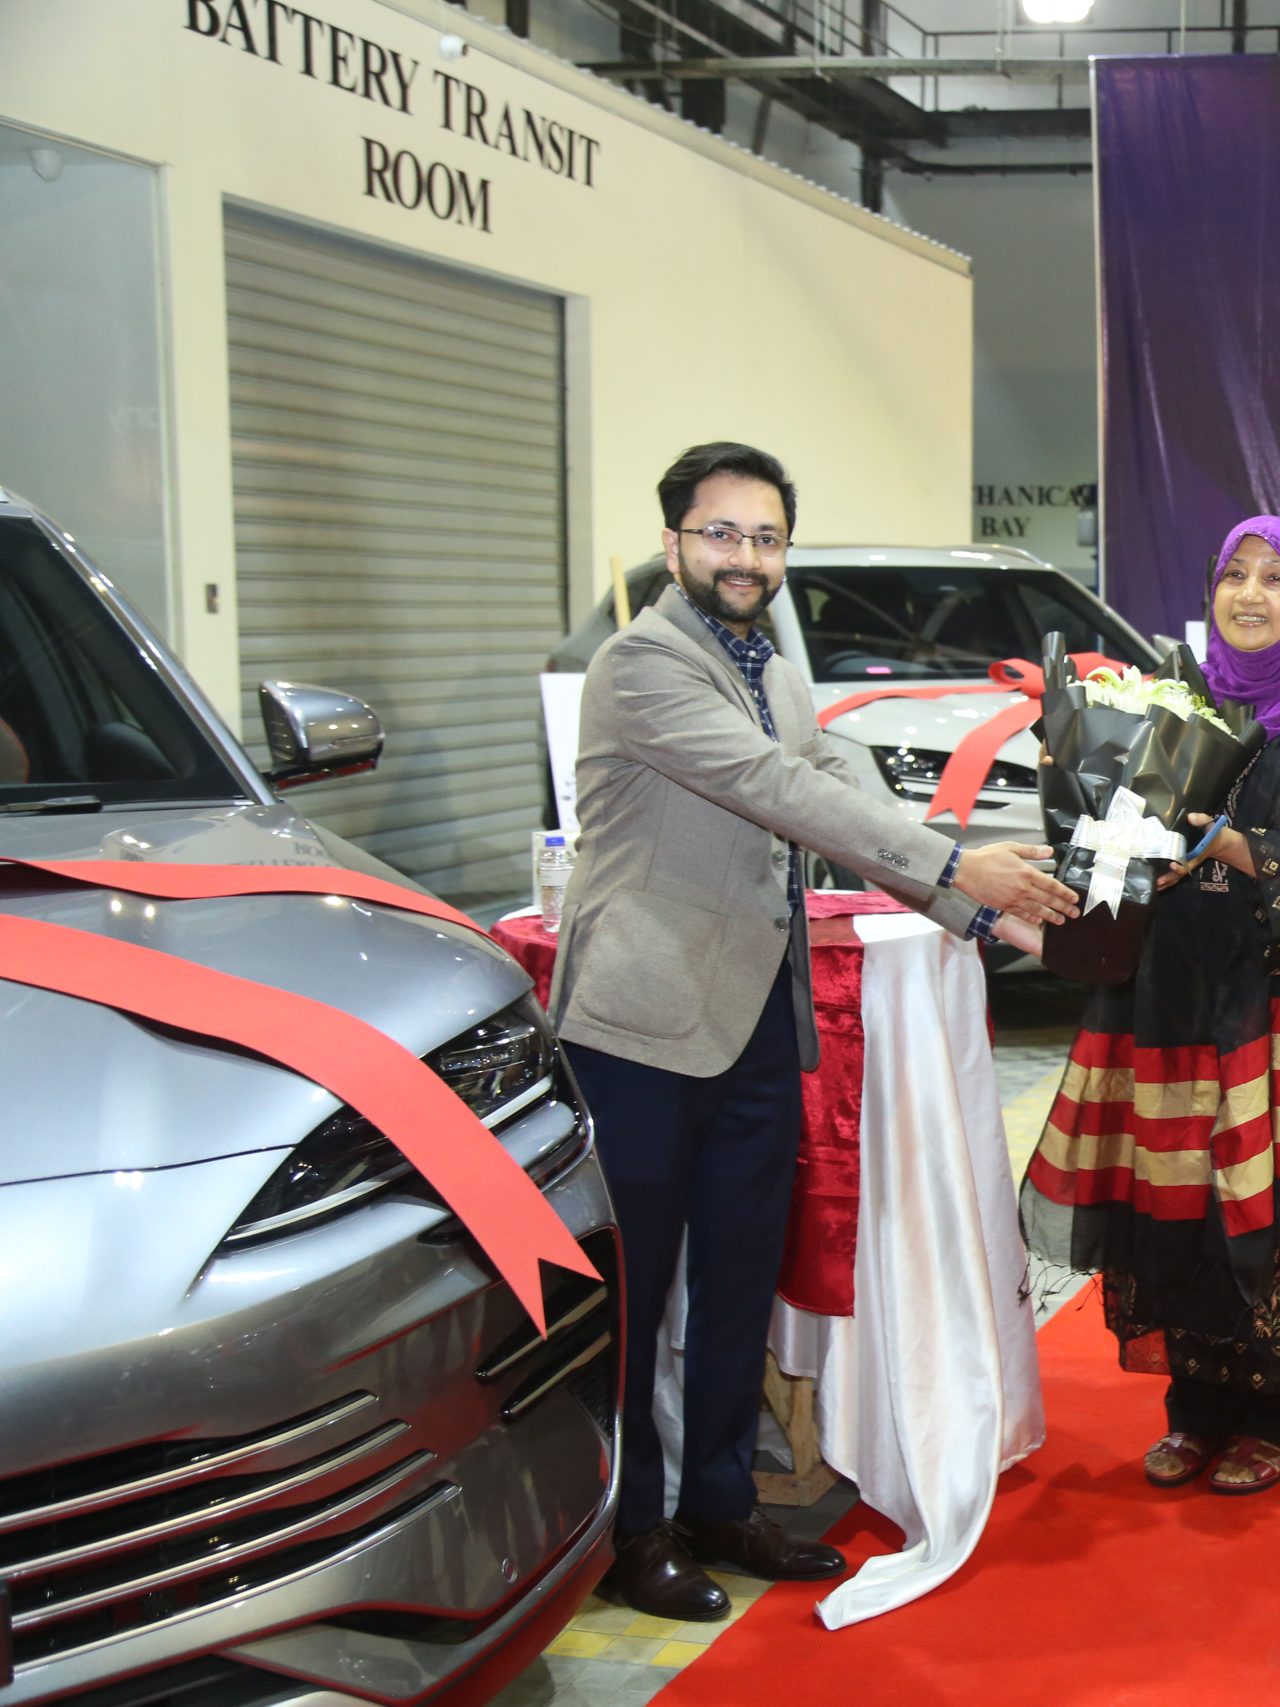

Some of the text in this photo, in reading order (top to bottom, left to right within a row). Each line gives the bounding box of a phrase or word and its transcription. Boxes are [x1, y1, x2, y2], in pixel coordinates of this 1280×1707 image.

[434, 69, 601, 188] TRANSIT
[360, 135, 493, 234] ROOM
[973, 484, 1083, 507] HANICA
[981, 516, 1030, 537] BAY
